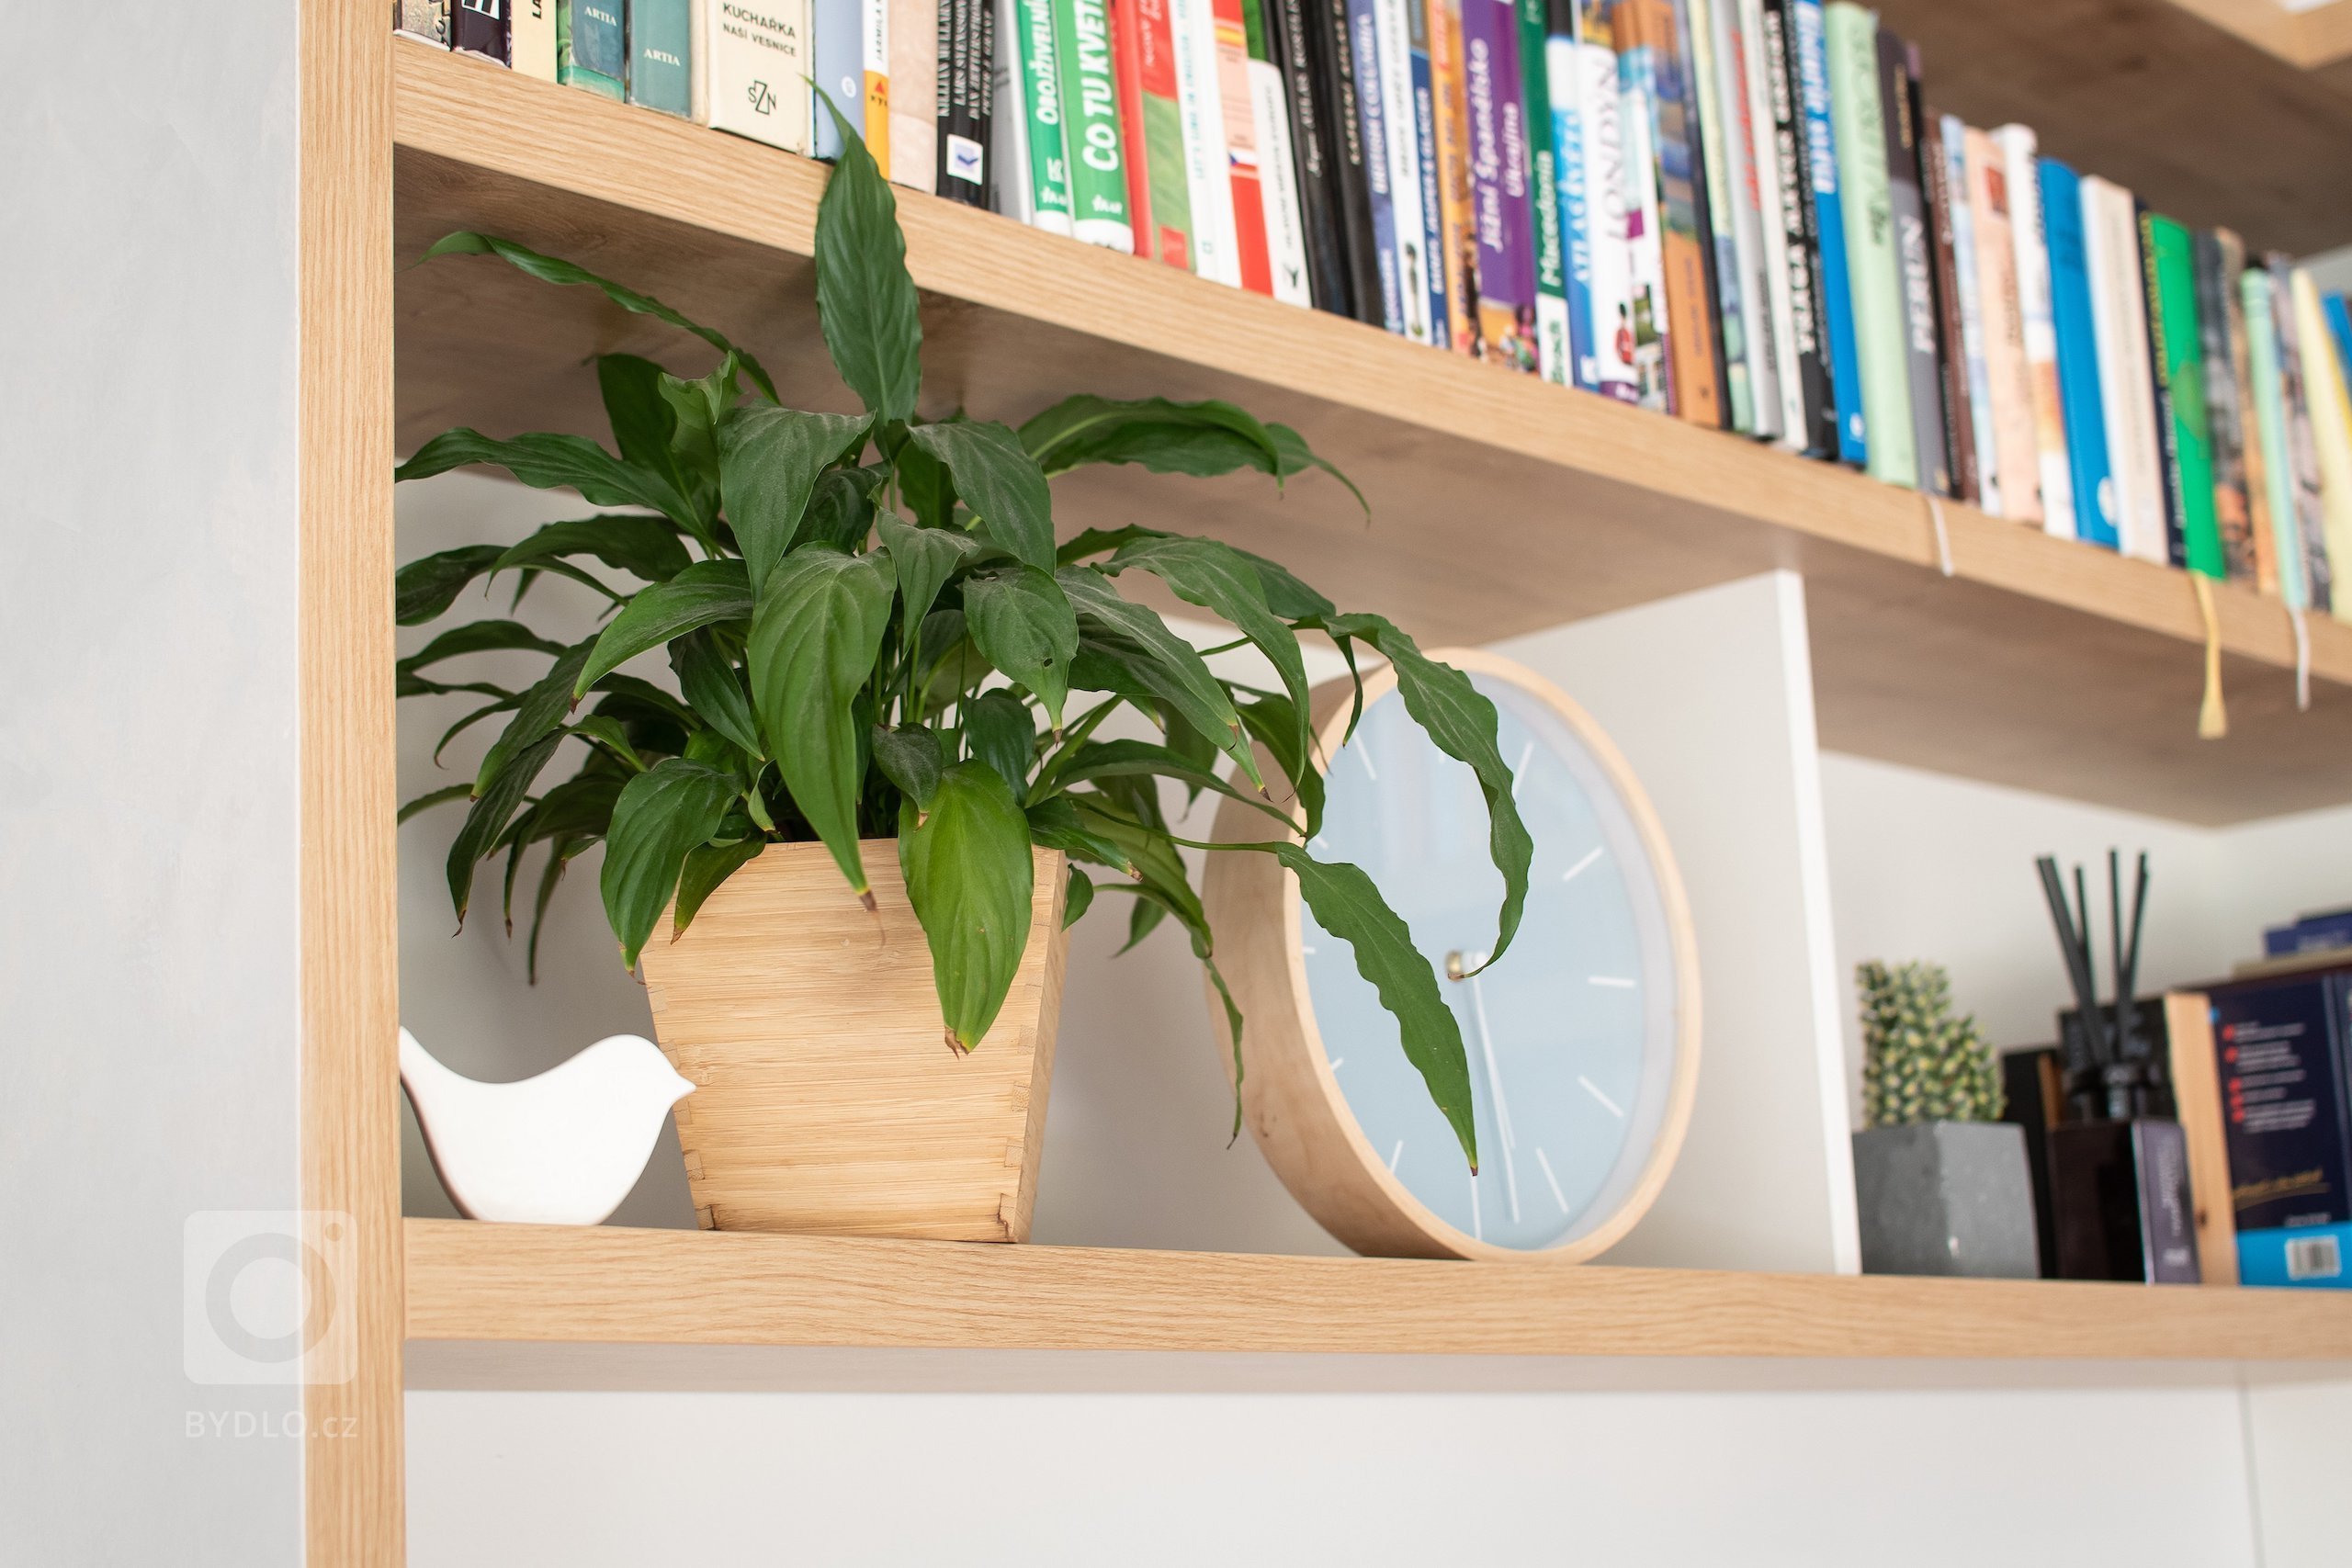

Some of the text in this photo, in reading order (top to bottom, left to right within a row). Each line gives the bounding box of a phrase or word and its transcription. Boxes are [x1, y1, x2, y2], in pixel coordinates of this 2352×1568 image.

[584, 6, 617, 27] ARTIA
[722, 4, 797, 39] KUCHAŘKA
[722, 23, 797, 57] NAŠI VESNICE
[643, 48, 681, 67] ARTIA
[1074, 0, 1120, 172] CO TU KVET
[1469, 38, 1500, 183] Španělsko
[1502, 101, 1527, 198] Ukrajina
[1534, 150, 1562, 288] Macedonia
